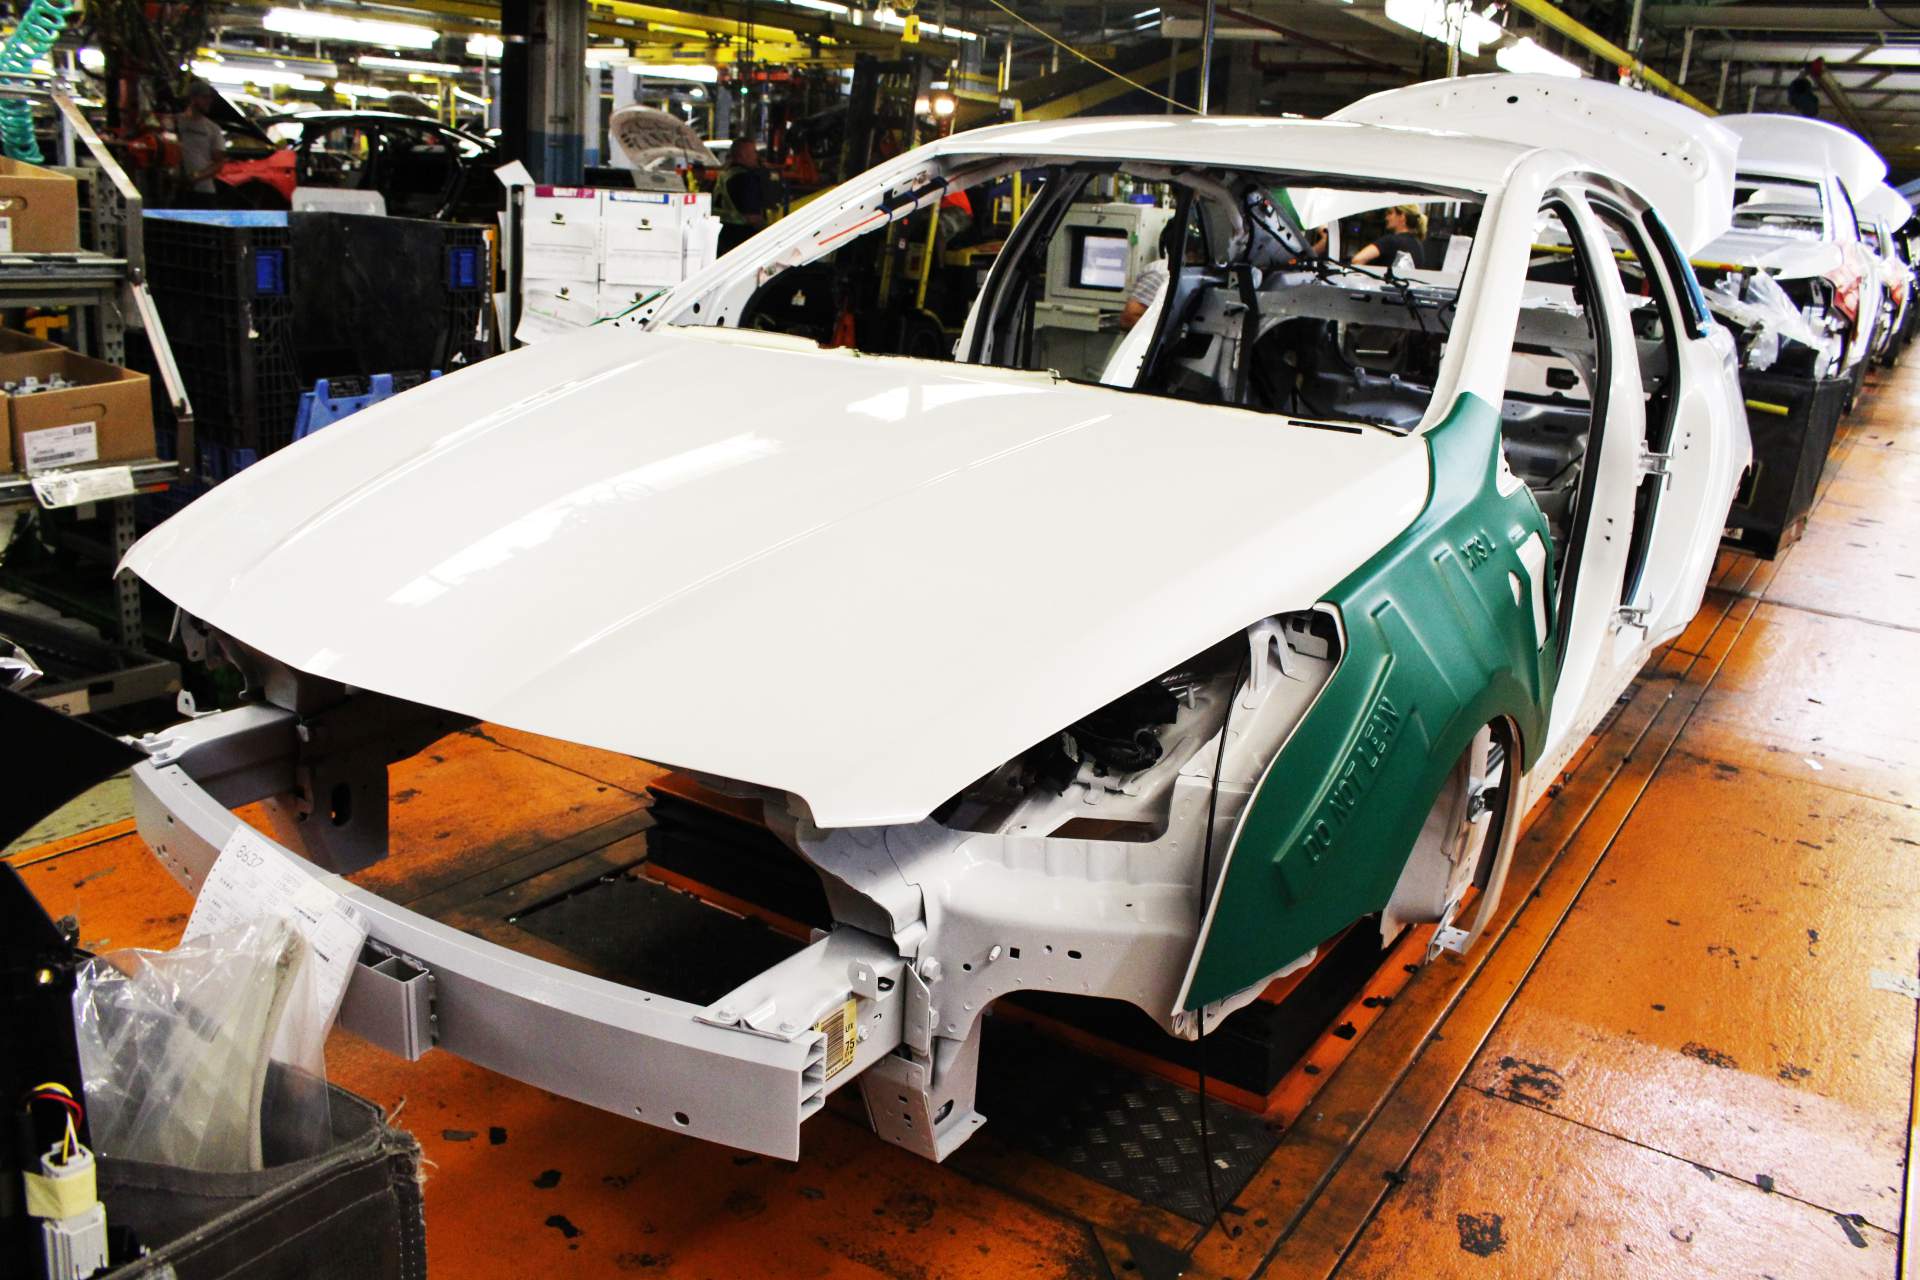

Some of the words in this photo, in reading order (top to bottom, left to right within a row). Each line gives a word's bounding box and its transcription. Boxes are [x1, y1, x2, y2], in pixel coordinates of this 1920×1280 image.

[1303, 819, 1332, 862] DO
[1329, 760, 1363, 826] NOT
[1357, 695, 1401, 776] LEAN
